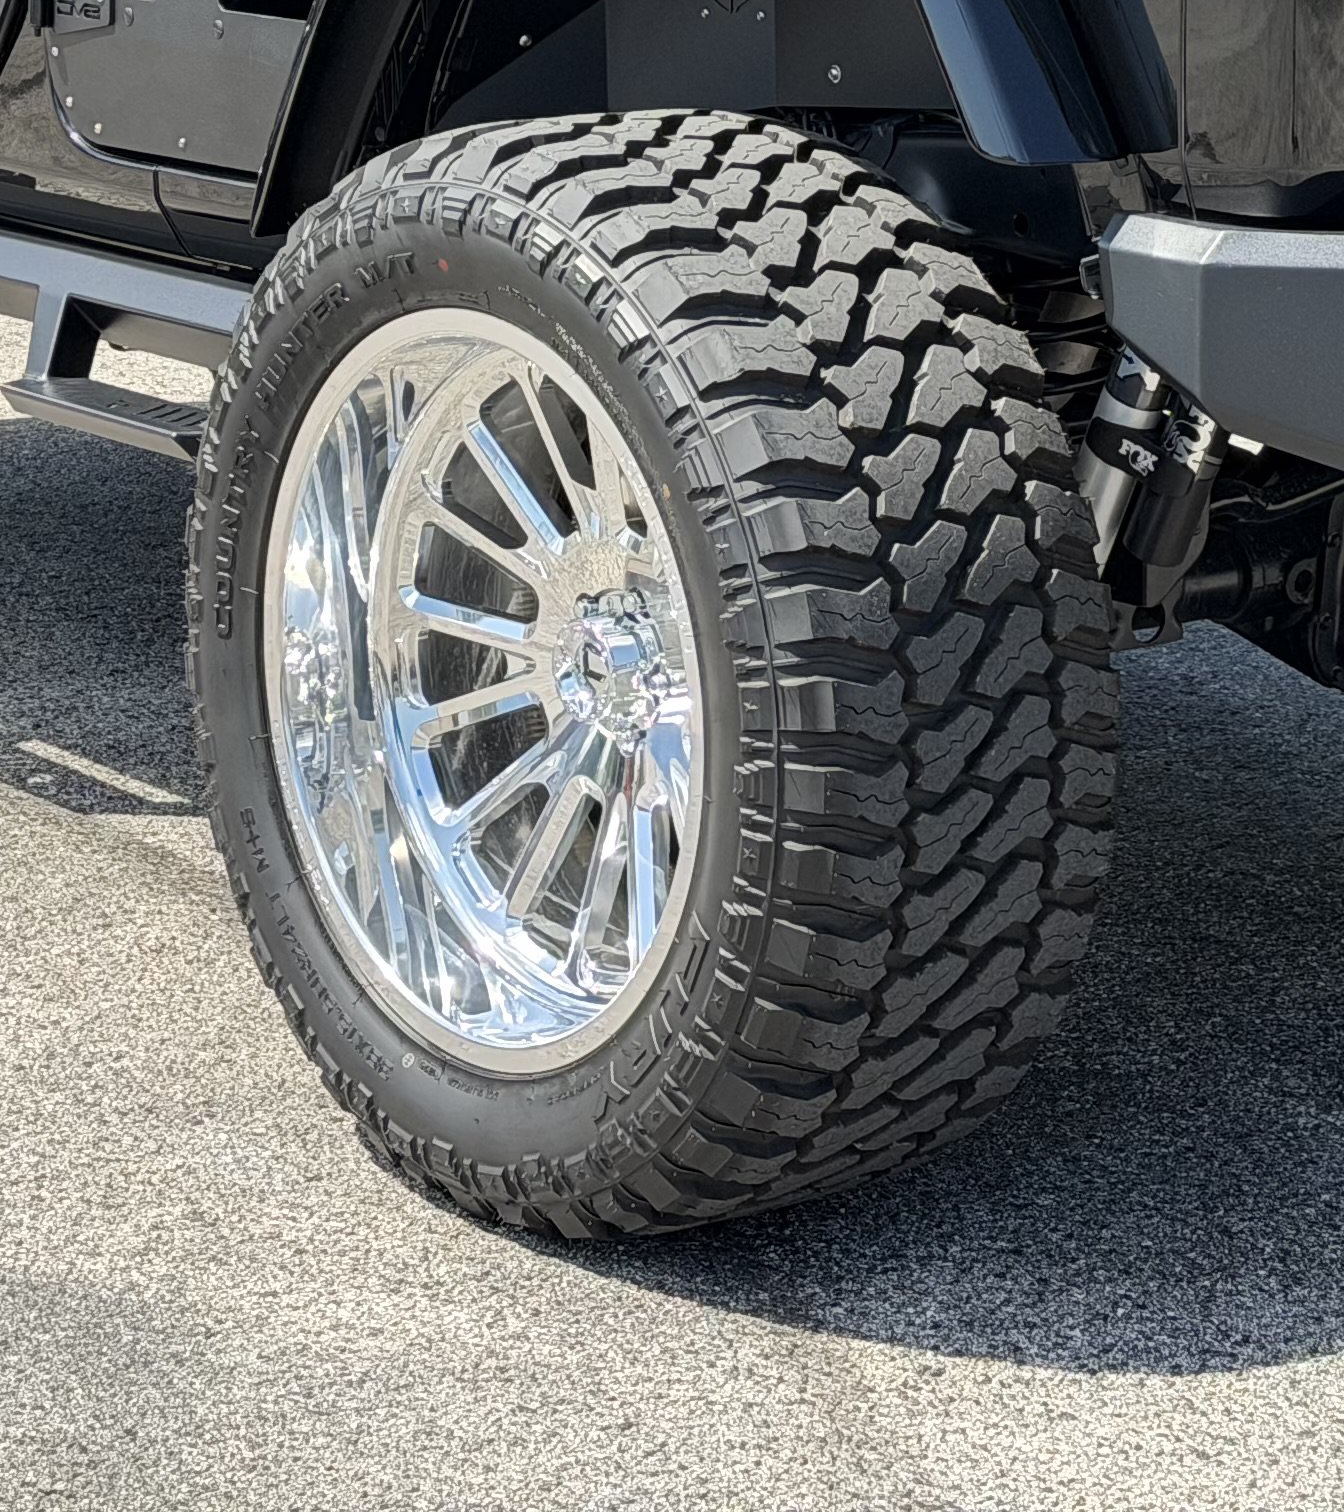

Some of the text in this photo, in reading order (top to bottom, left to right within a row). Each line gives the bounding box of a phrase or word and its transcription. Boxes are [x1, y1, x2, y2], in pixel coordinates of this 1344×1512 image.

[214, 250, 417, 640] COUNTRY HUNTER M/T
[1117, 437, 1159, 477] FOX
